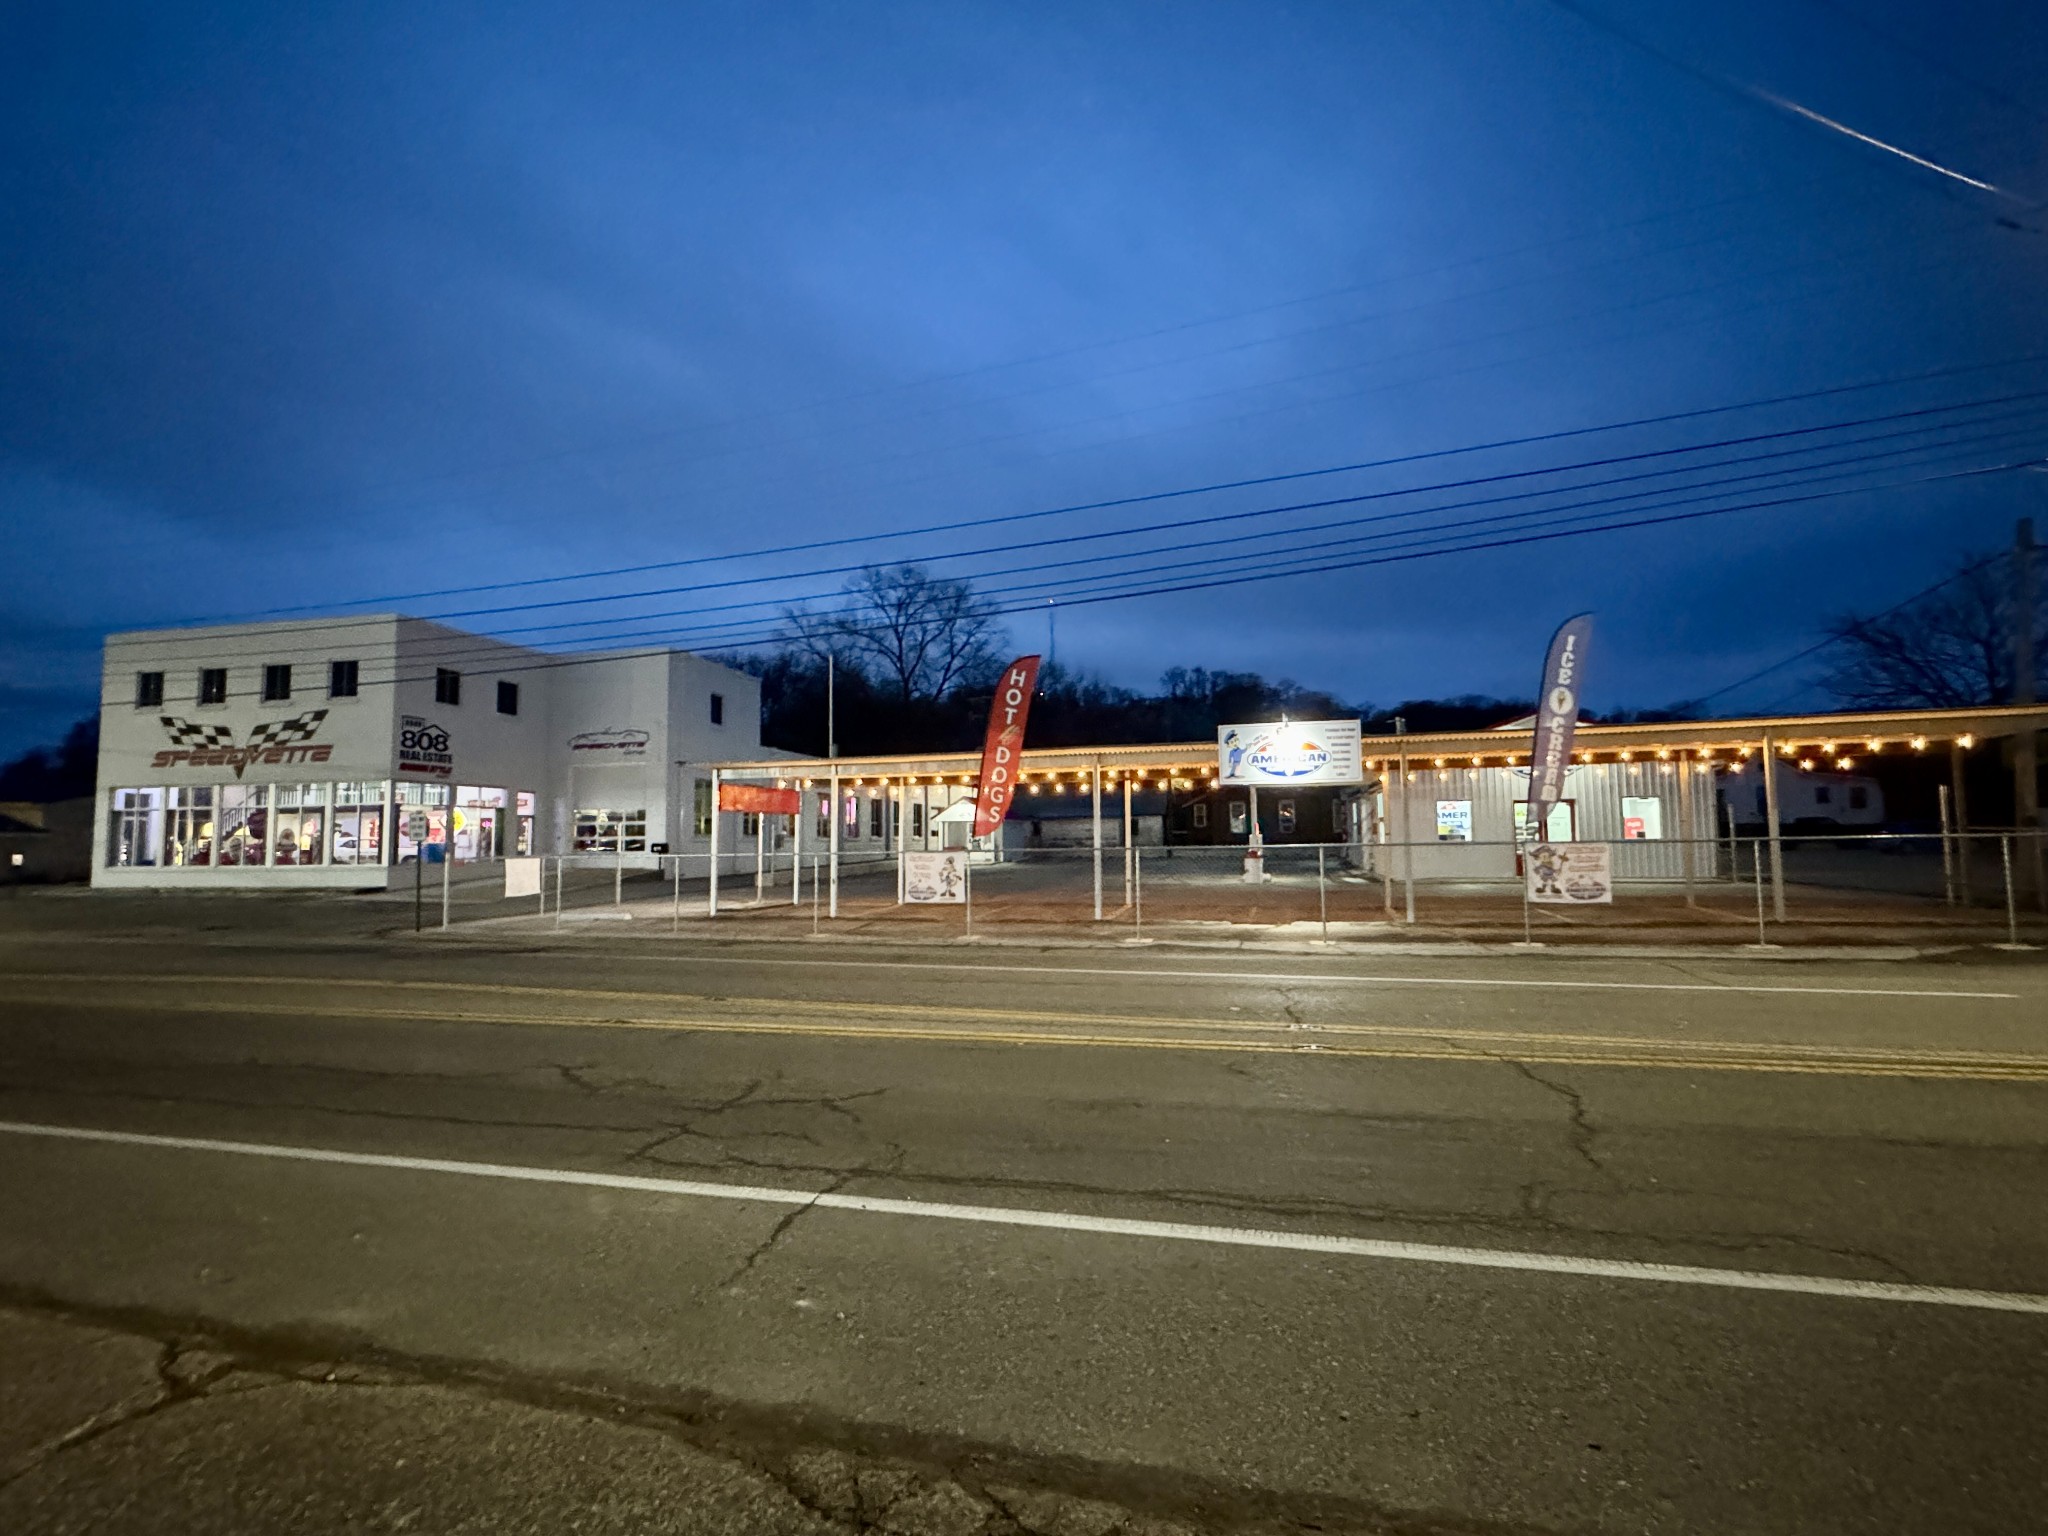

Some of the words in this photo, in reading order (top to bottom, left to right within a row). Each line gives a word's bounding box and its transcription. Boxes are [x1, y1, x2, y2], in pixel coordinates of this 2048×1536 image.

[1557, 635, 1576, 686] ICE
[1003, 668, 1026, 725] HOT
[401, 729, 448, 751] 808
[1251, 753, 1327, 764] AMECAN
[989, 746, 1011, 823] DOGS
